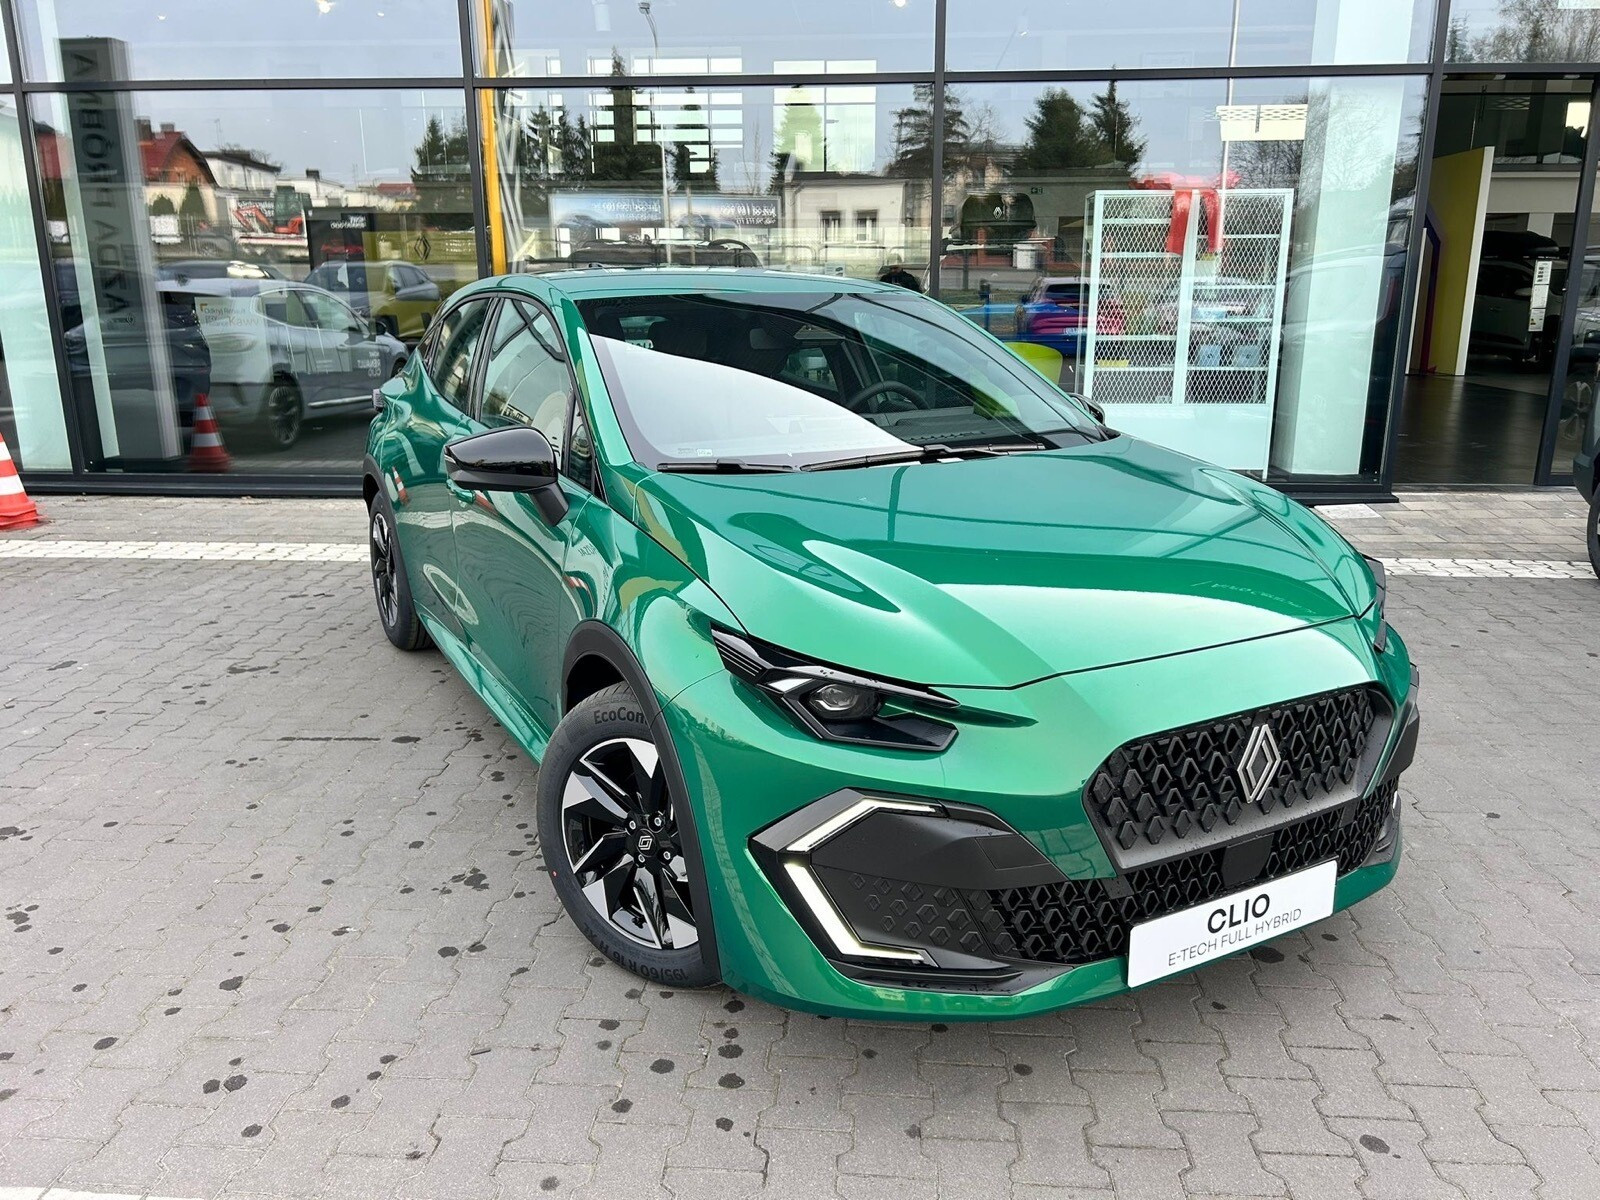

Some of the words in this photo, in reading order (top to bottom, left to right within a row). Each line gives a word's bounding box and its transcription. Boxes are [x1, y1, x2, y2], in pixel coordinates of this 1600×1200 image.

[593, 706, 648, 726] EcoCon
[1207, 893, 1270, 934] CLIO
[1168, 938, 1217, 967] E-TECH
[1221, 927, 1252, 948] FULL
[1254, 908, 1302, 936] HYBRID
[612, 951, 626, 967] 16
[628, 959, 638, 974] R
[640, 965, 690, 981] 195/60
